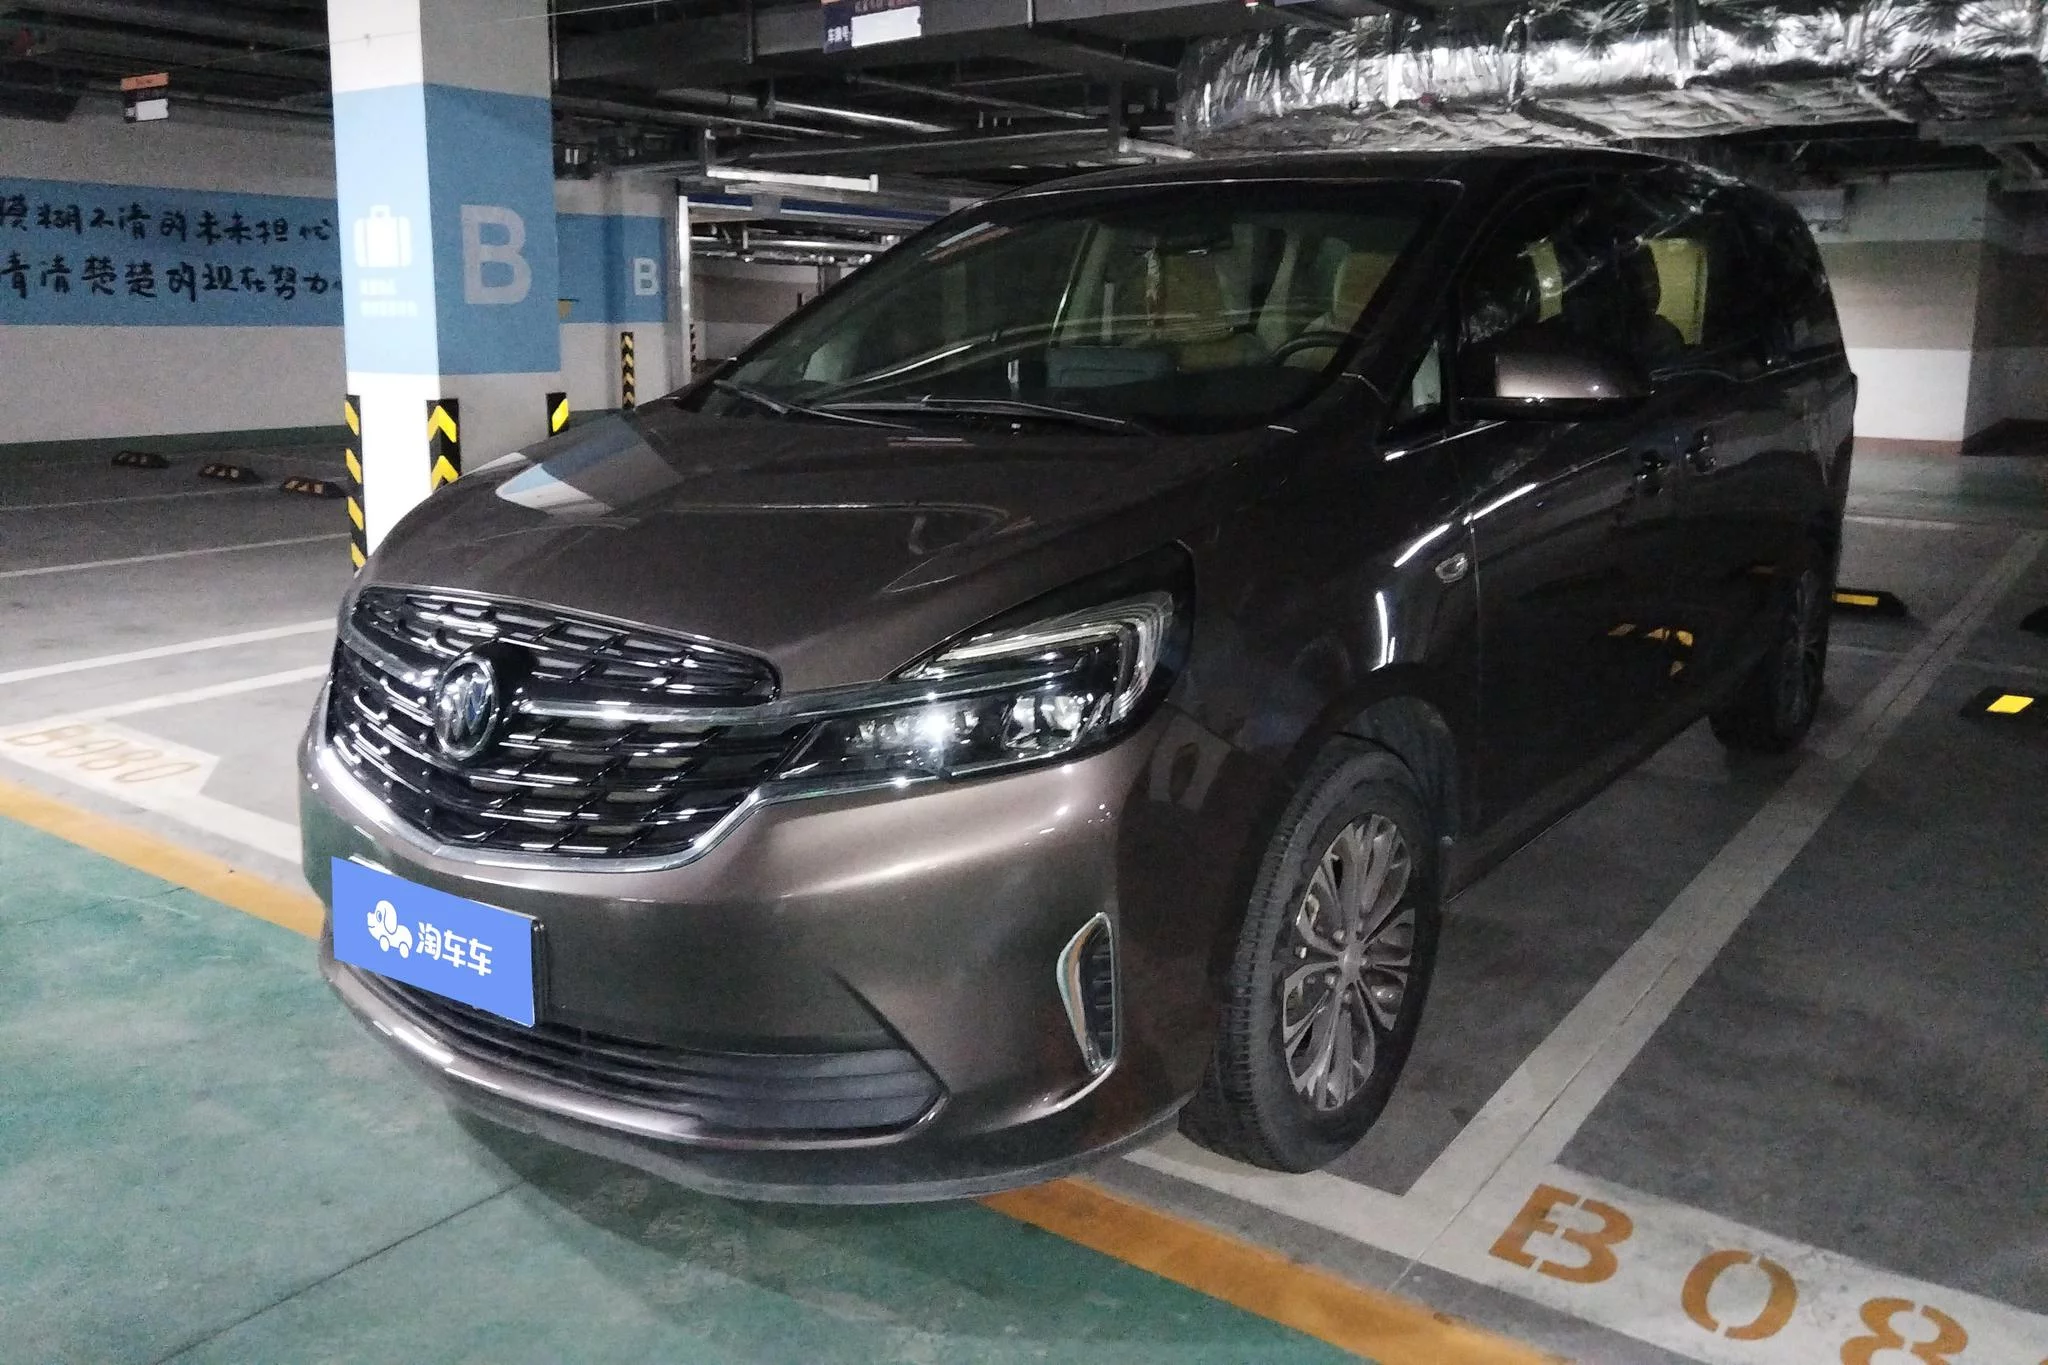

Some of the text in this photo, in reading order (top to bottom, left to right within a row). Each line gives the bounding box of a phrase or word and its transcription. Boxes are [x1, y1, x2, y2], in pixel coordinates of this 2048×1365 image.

[461, 204, 533, 304] B
[633, 257, 661, 296] B
[1488, 1182, 2048, 1365] B08
